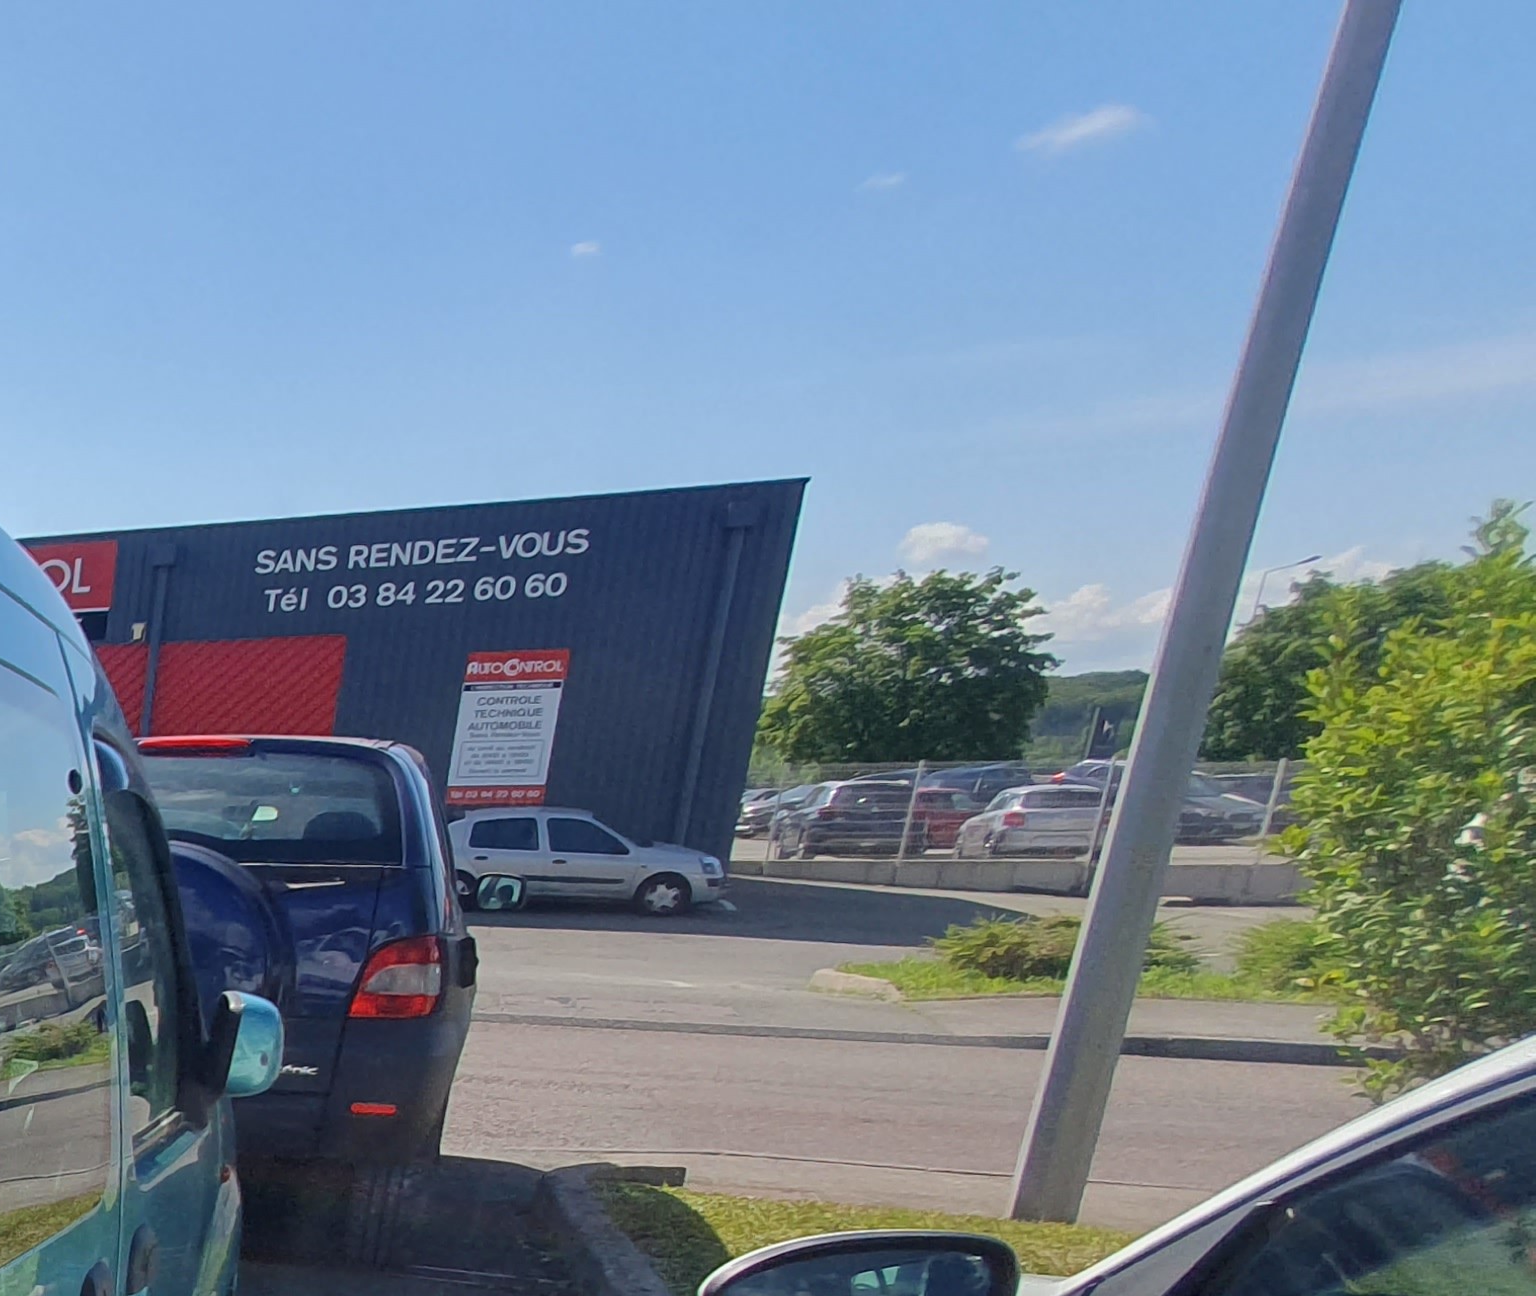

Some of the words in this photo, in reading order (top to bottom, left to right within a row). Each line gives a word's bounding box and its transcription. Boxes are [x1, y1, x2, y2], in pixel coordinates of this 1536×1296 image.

[254, 546, 338, 574] SANS
[347, 528, 591, 570] RENDEZ-VOUS
[263, 586, 310, 613] Tél
[326, 584, 368, 609] 03
[376, 581, 417, 606] 84
[424, 578, 465, 604] 22
[473, 575, 517, 600] 60
[523, 572, 568, 598] 60
[467, 719, 543, 732] AUTOMOBILE
[474, 707, 544, 719] TECHNIQUE
